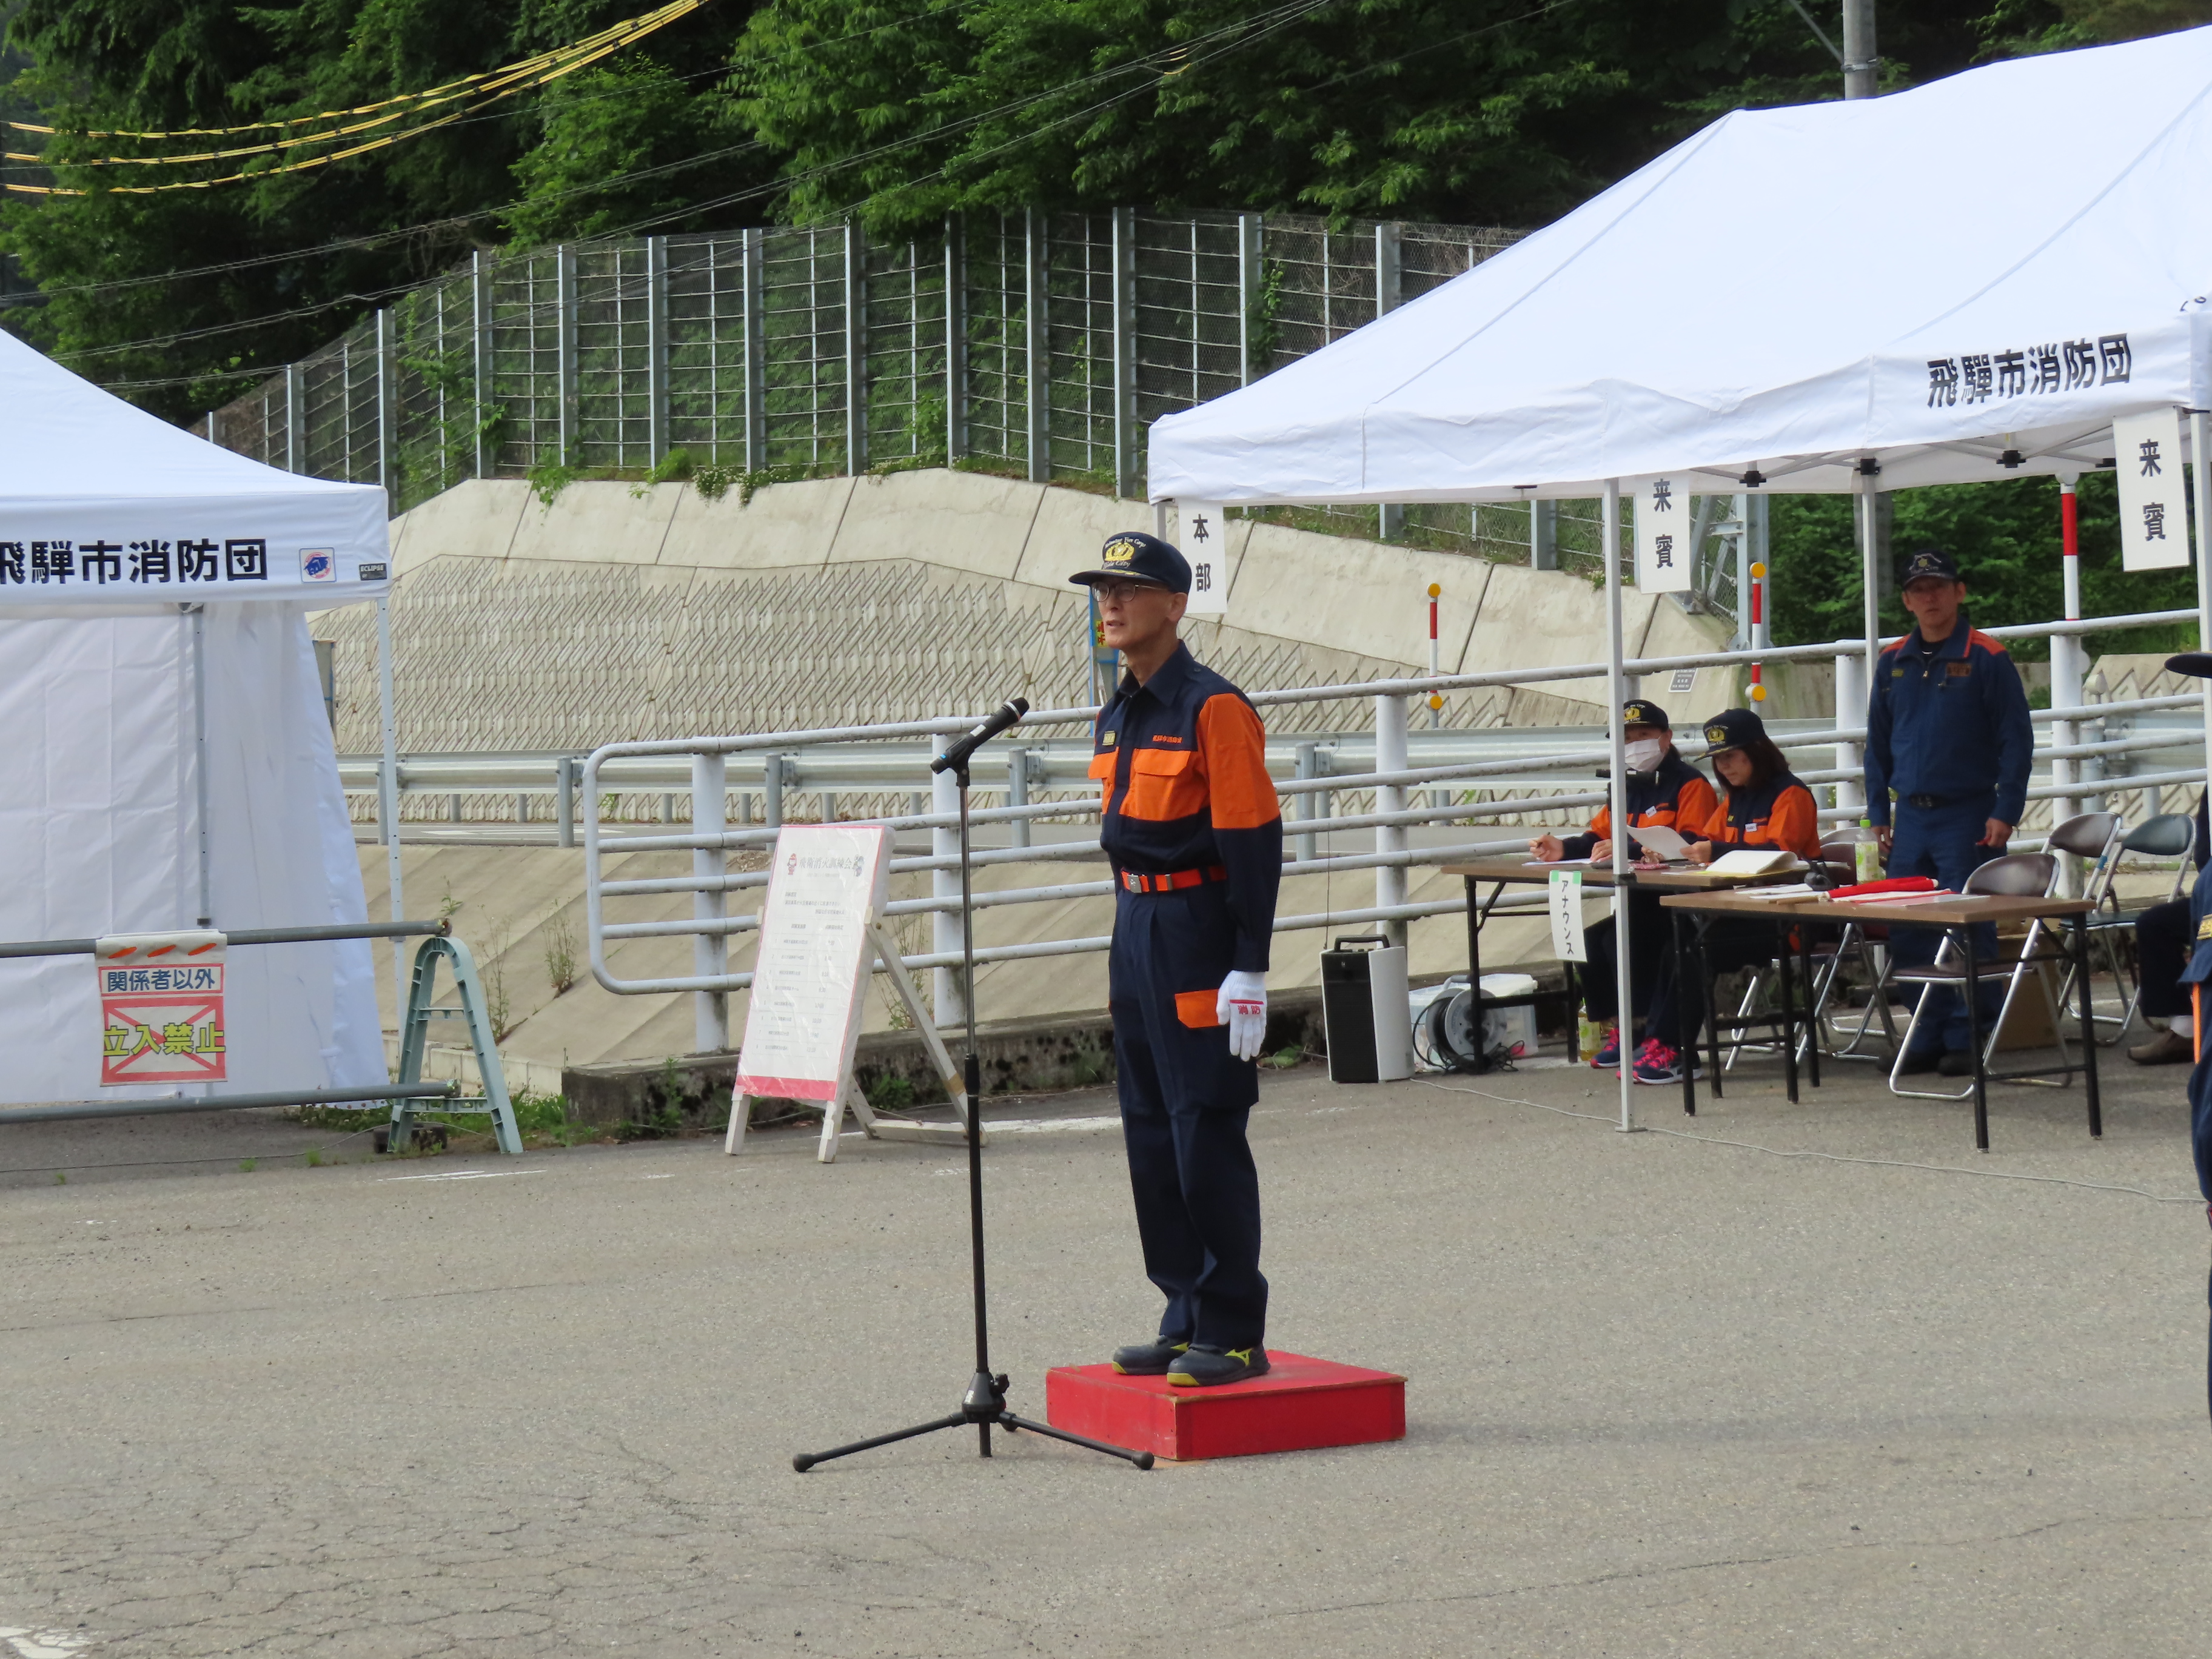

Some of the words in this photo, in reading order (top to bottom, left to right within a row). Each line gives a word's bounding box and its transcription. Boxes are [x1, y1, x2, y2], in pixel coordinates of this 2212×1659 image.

[1653, 478, 1674, 569] 来賓
[2139, 438, 2167, 541] 来賓
[1116, 560, 1131, 569] City
[1192, 514, 1211, 592] 本部
[1561, 880, 1574, 955] アナウンス
[107, 968, 215, 993] 関係者以外
[103, 1022, 226, 1057] 立入禁止
